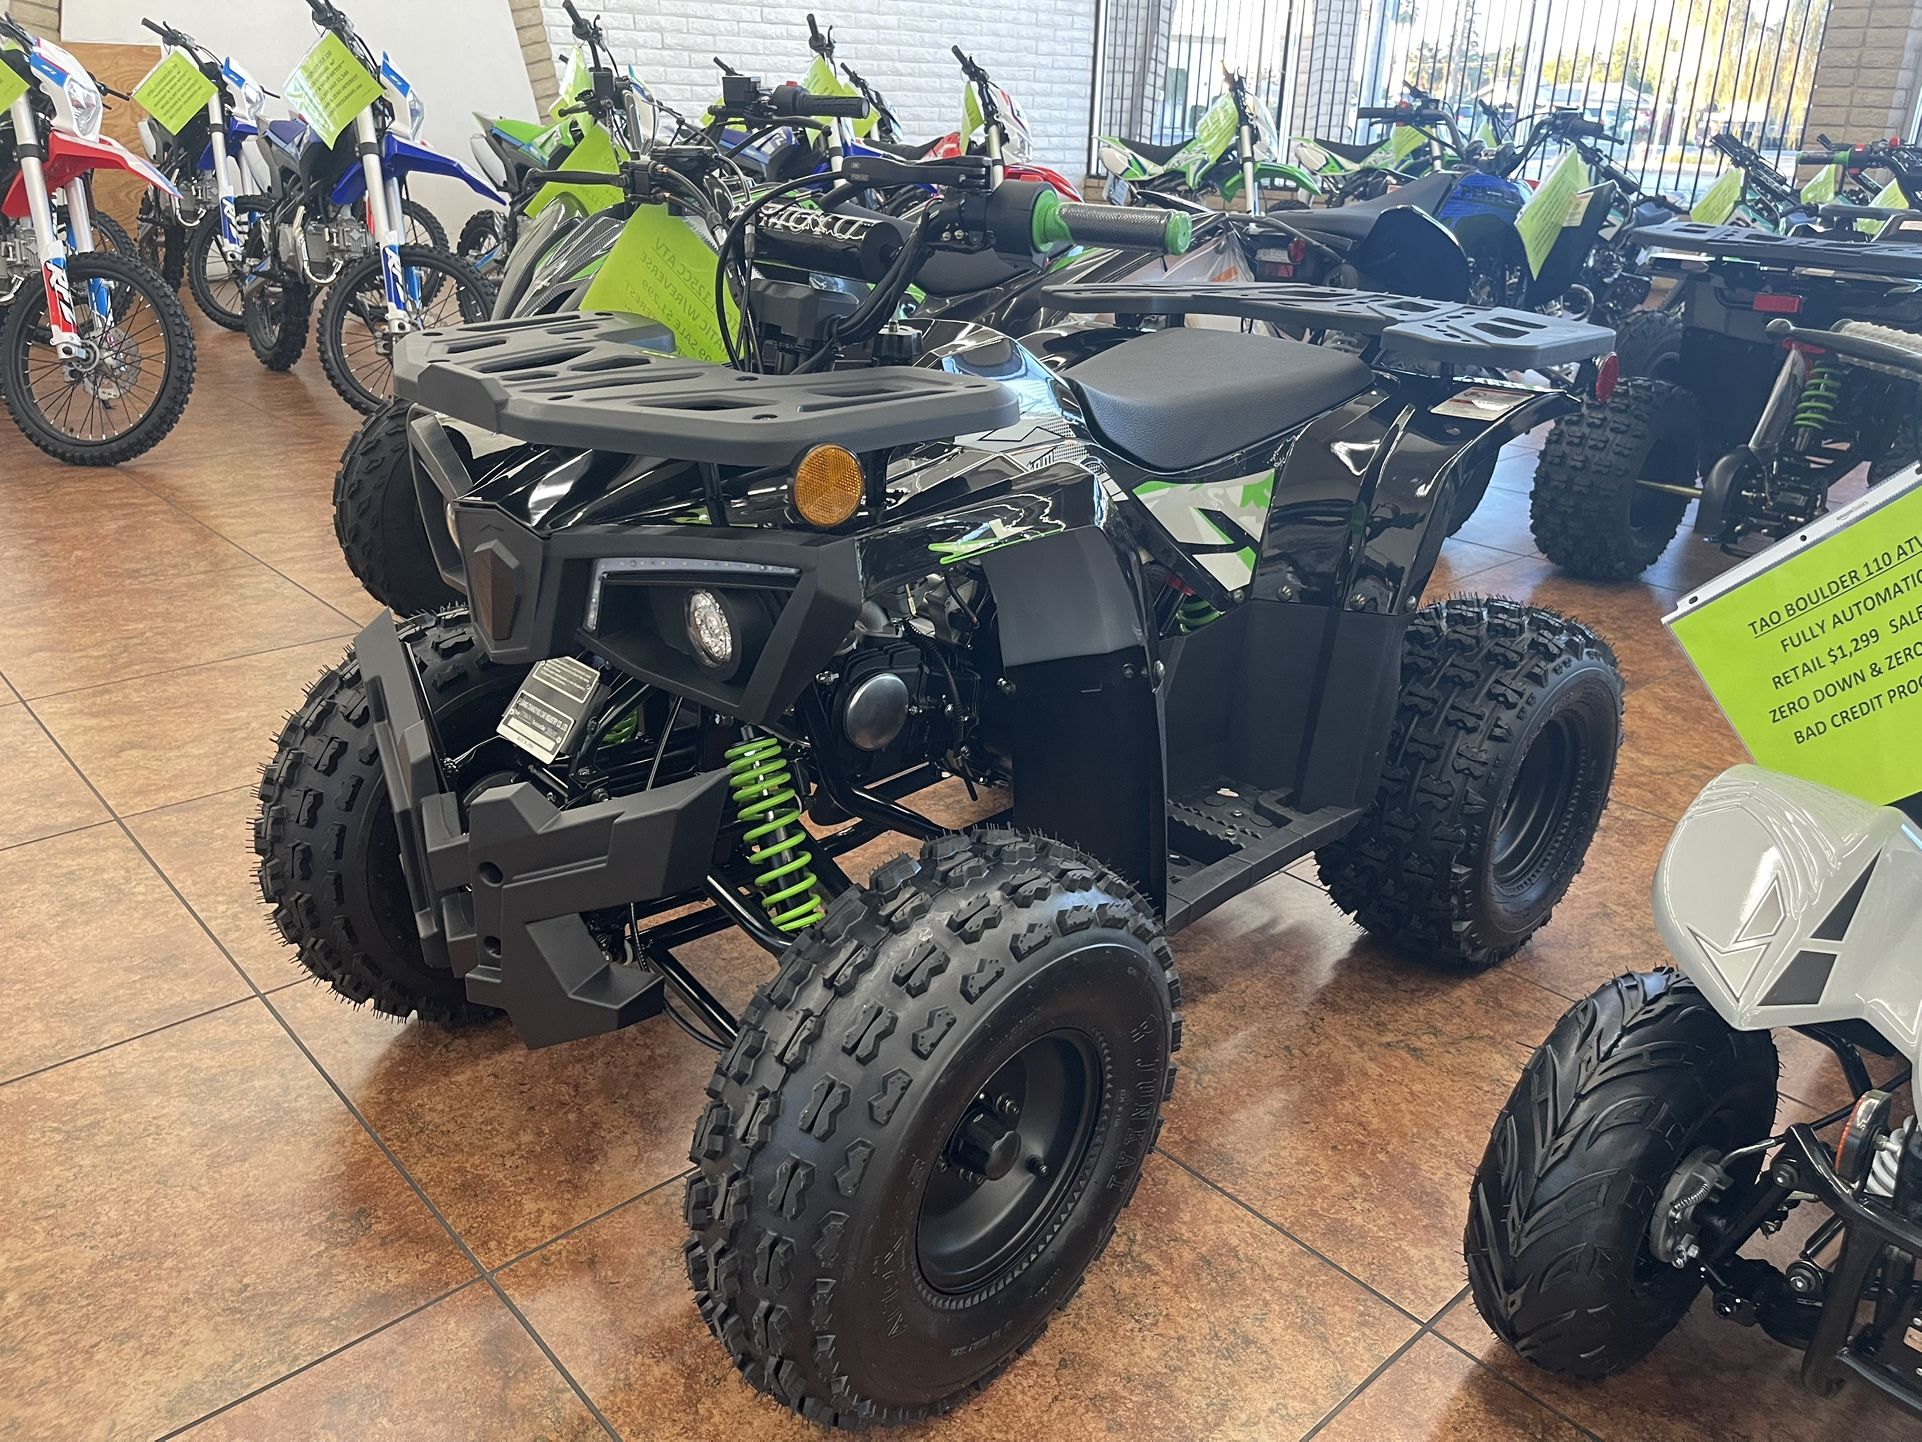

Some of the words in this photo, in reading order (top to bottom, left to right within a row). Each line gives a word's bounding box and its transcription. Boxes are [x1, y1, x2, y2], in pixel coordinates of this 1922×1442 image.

[1748, 611, 1781, 635] TAO
[1784, 569, 1860, 618] BOULDER
[1863, 552, 1892, 577] 110
[1772, 657, 1826, 690] RETAIL
[1827, 628, 1880, 665] $1,299
[1780, 619, 1826, 653] FULLY
[1768, 695, 1810, 724] ZERO
[1813, 669, 1866, 703] DOWN
[1869, 662, 1883, 678] &
[1884, 641, 1922, 671] ZERO
[1793, 721, 1827, 744] BAD
[1831, 693, 1883, 728] CREDIT
